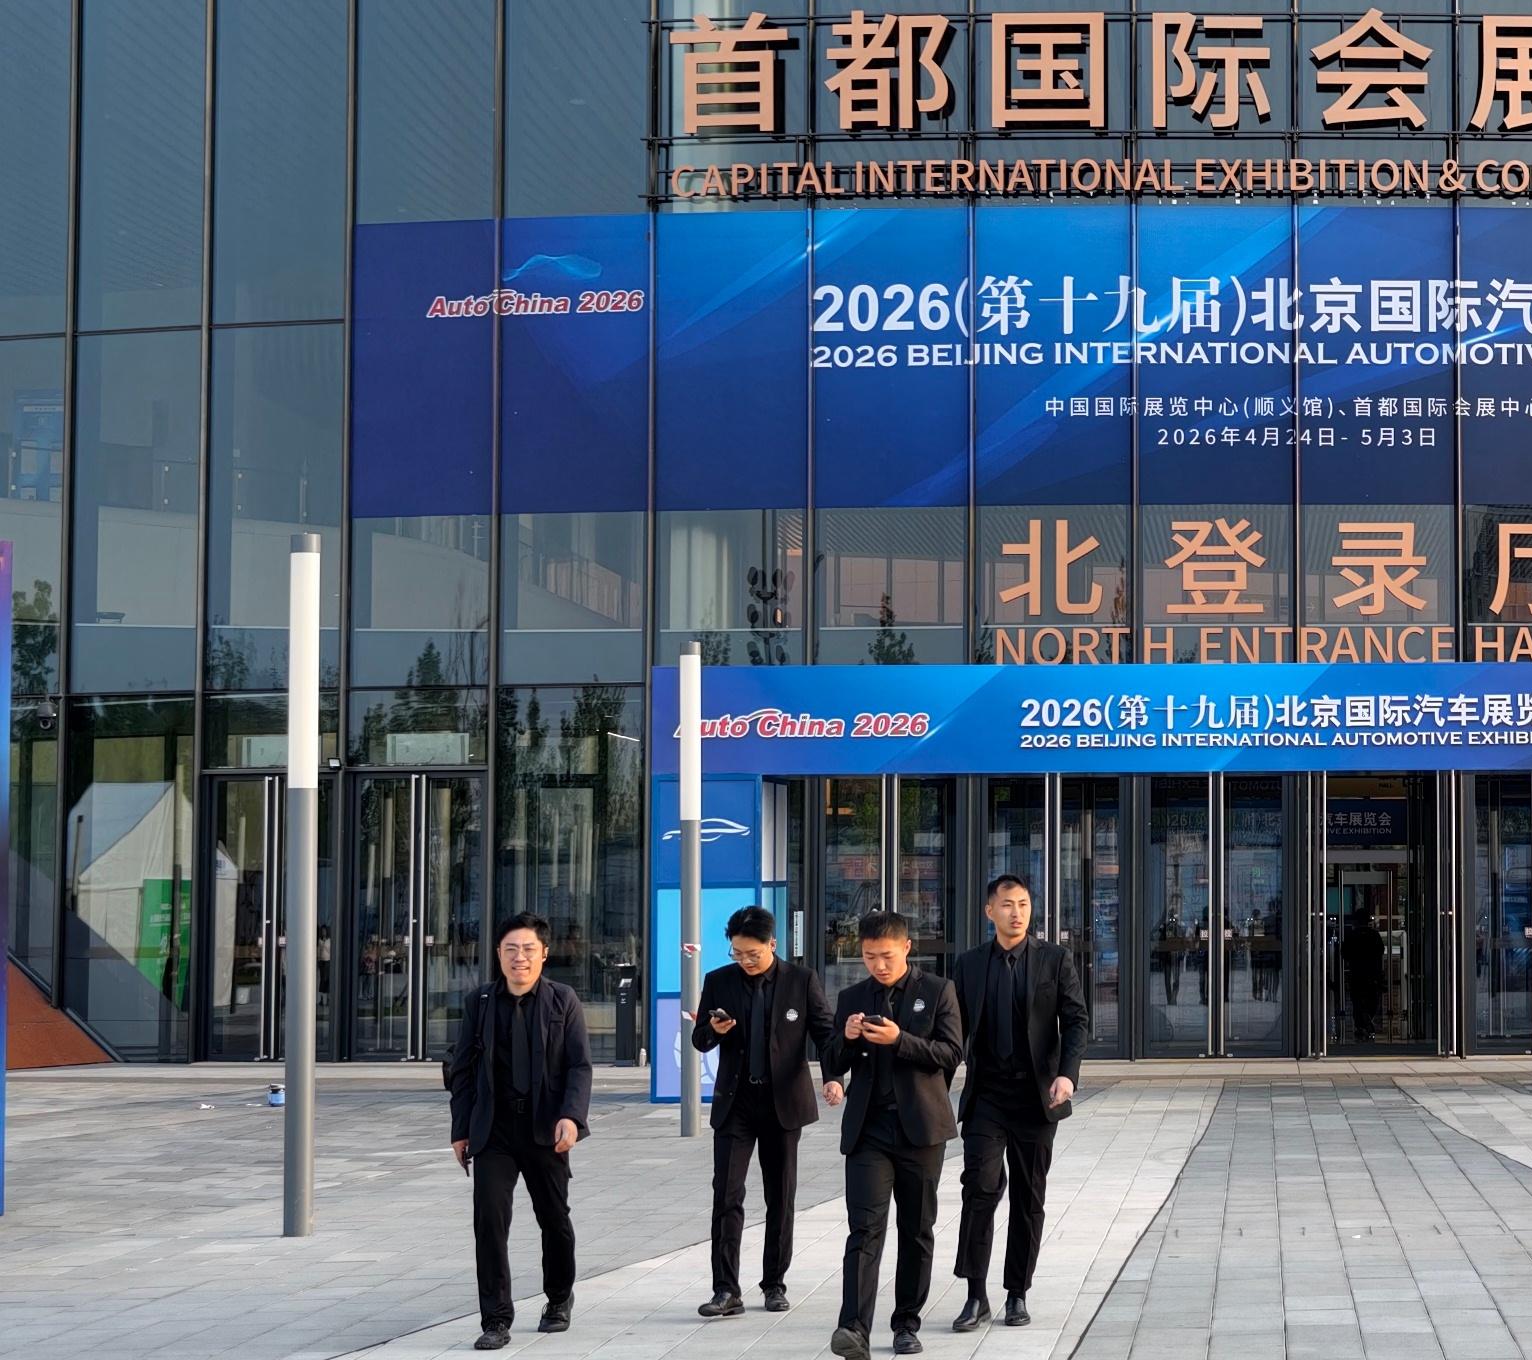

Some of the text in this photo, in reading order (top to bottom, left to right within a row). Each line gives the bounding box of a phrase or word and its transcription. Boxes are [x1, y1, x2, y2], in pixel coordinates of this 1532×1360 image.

[671, 160, 845, 197] CAPITAL
[855, 159, 1184, 194] INTERNATIONAL
[1195, 159, 1429, 193] EXHIBITION
[427, 290, 646, 318] Auto China 2026
[811, 344, 898, 368] 2026
[907, 342, 1044, 367] BEIJING
[1055, 342, 1337, 365] INTERNATIONAL
[995, 626, 1175, 664] NORTH
[1200, 625, 1454, 663] ENTRANCE
[675, 709, 930, 739] uto China 2026
[1020, 734, 1072, 748] 2026
[1076, 733, 1157, 748] BEIJING
[1162, 732, 1327, 747] INTERNATIONAL
[1332, 731, 1464, 747] AUTOMOTIVE
